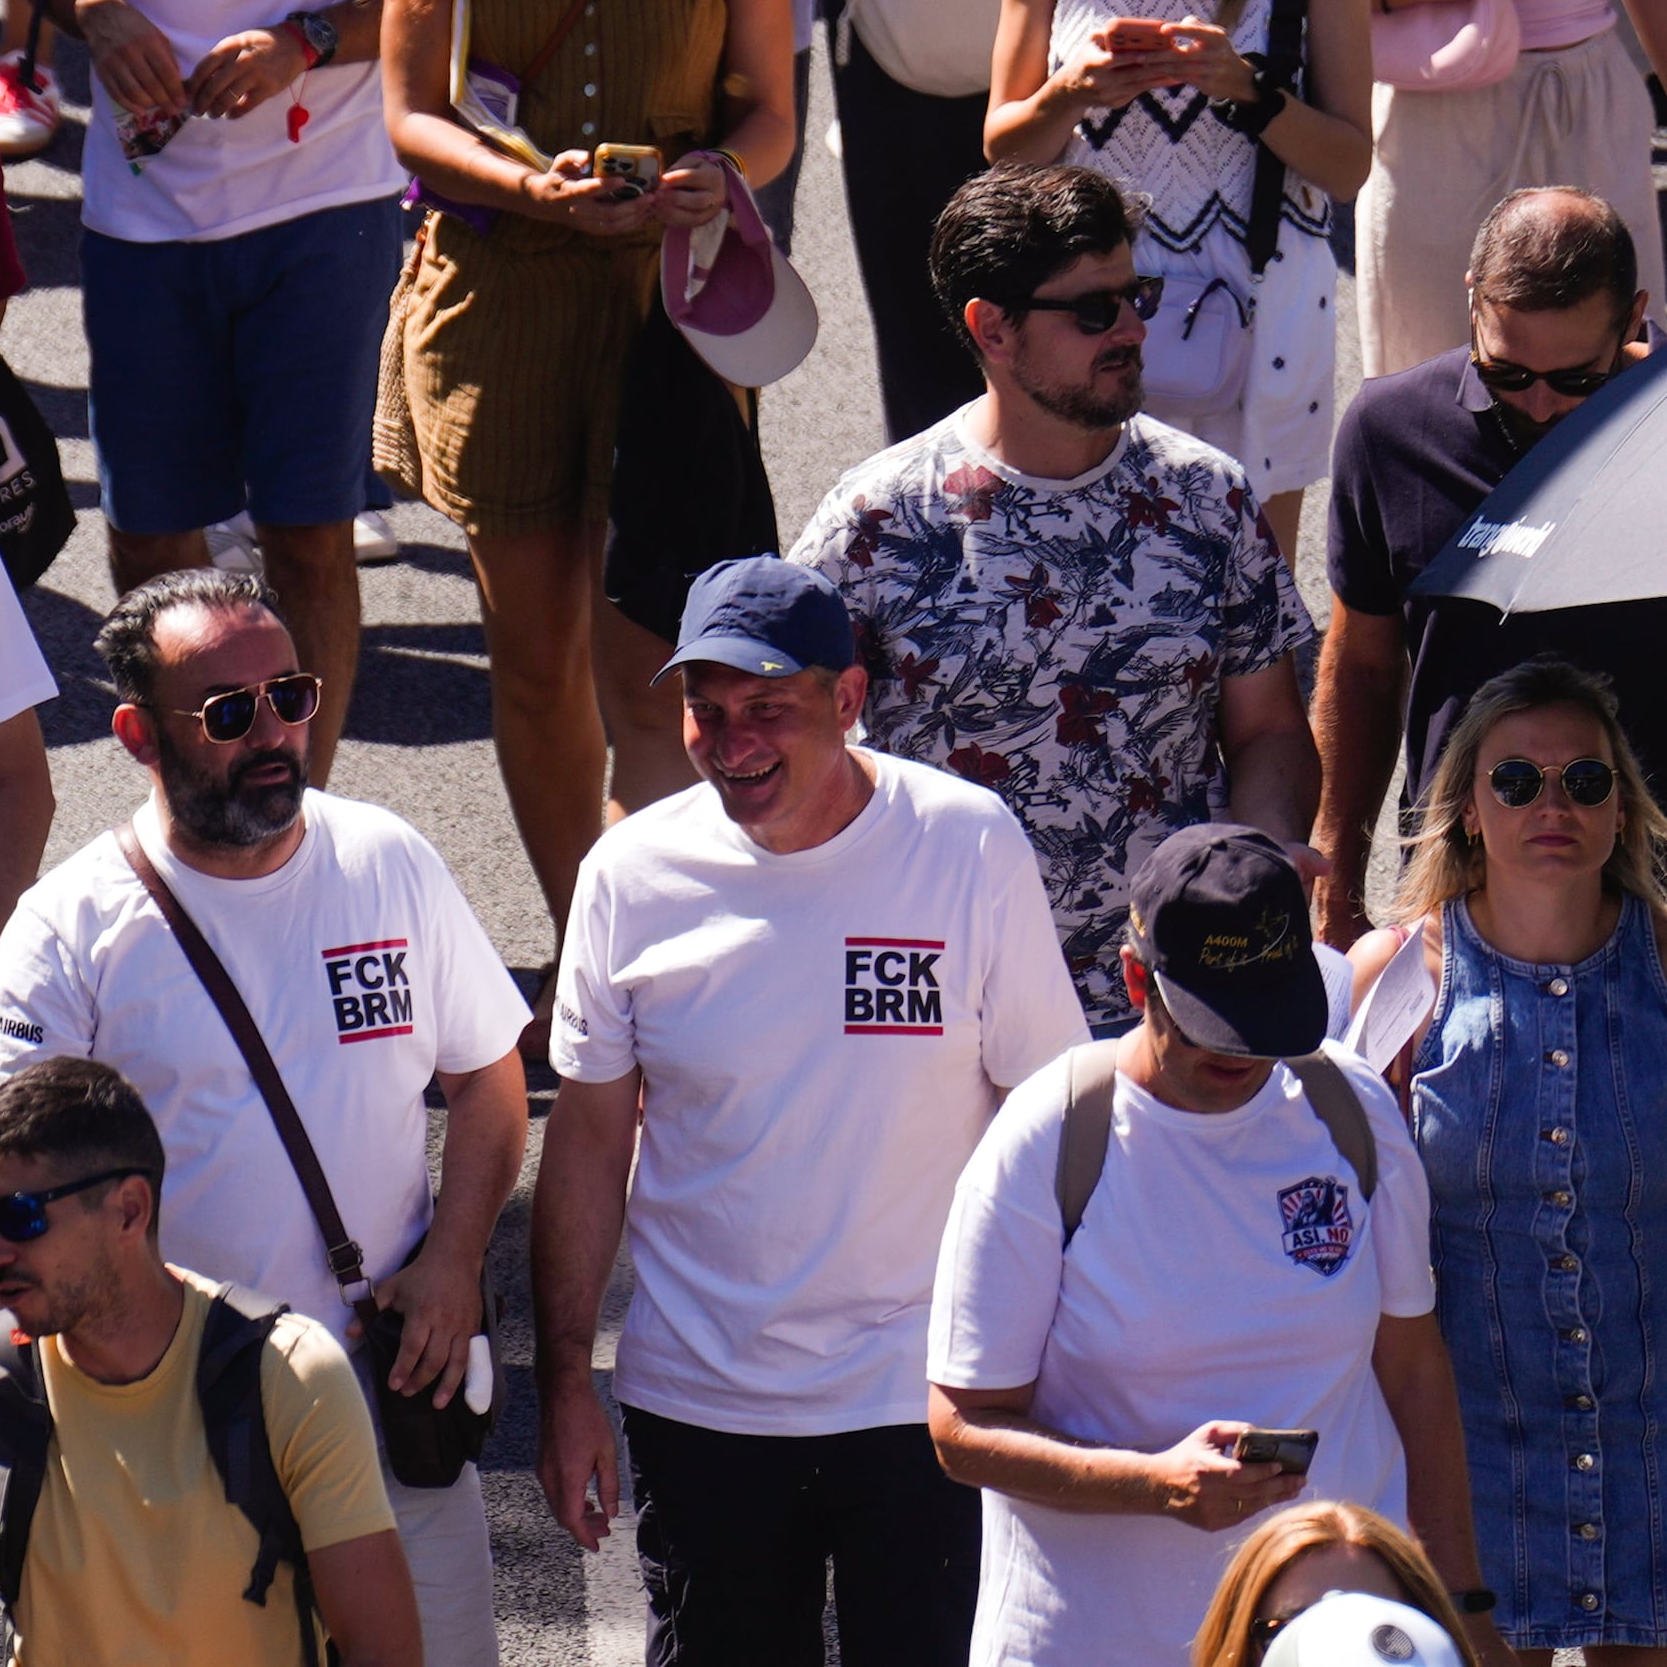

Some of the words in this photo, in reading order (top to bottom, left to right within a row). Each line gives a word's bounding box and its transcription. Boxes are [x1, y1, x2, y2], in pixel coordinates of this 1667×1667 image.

[1203, 935, 1249, 948] A400M
[325, 952, 409, 996] FCK
[845, 950, 941, 988] FCK
[332, 989, 413, 1032] BRM
[844, 988, 942, 1023] BRM
